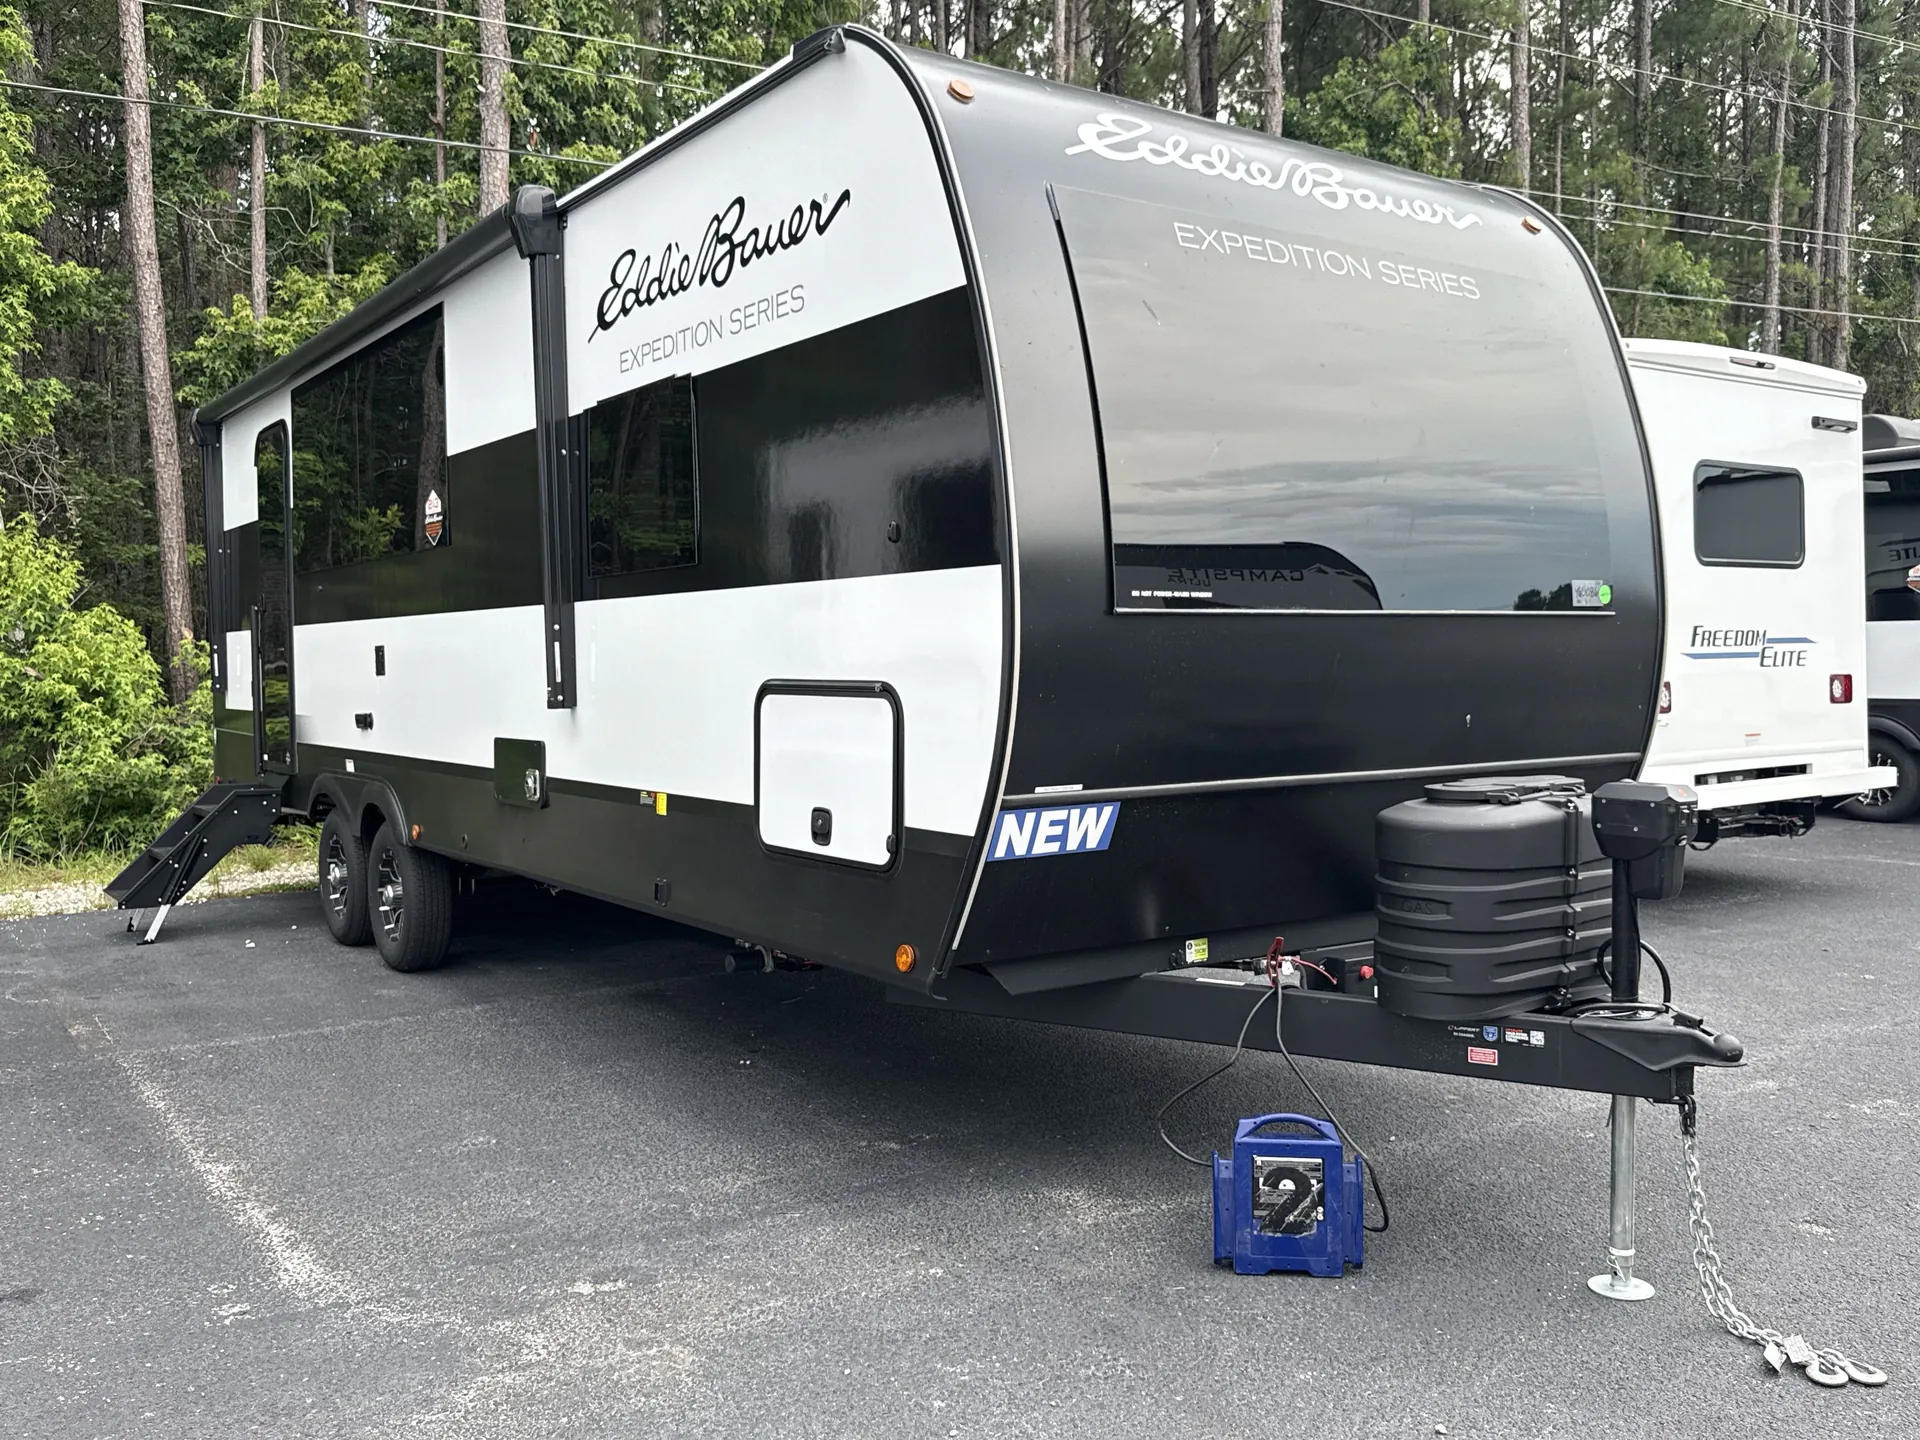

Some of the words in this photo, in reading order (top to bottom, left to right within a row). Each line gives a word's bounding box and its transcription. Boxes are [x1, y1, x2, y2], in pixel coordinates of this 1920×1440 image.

[1065, 112, 1281, 190] Eddie
[1281, 158, 1483, 230] Bauer
[588, 242, 697, 344] Eddie
[698, 189, 851, 288] Bauer
[1173, 221, 1372, 280] EXPEDITION
[1378, 259, 1481, 300] SERIES
[619, 314, 723, 374] EXPEDITION
[728, 284, 805, 335] SERIES
[1690, 625, 1767, 647] FREEDOM
[1759, 646, 1807, 668] ELITE
[993, 805, 1114, 859] NEW
